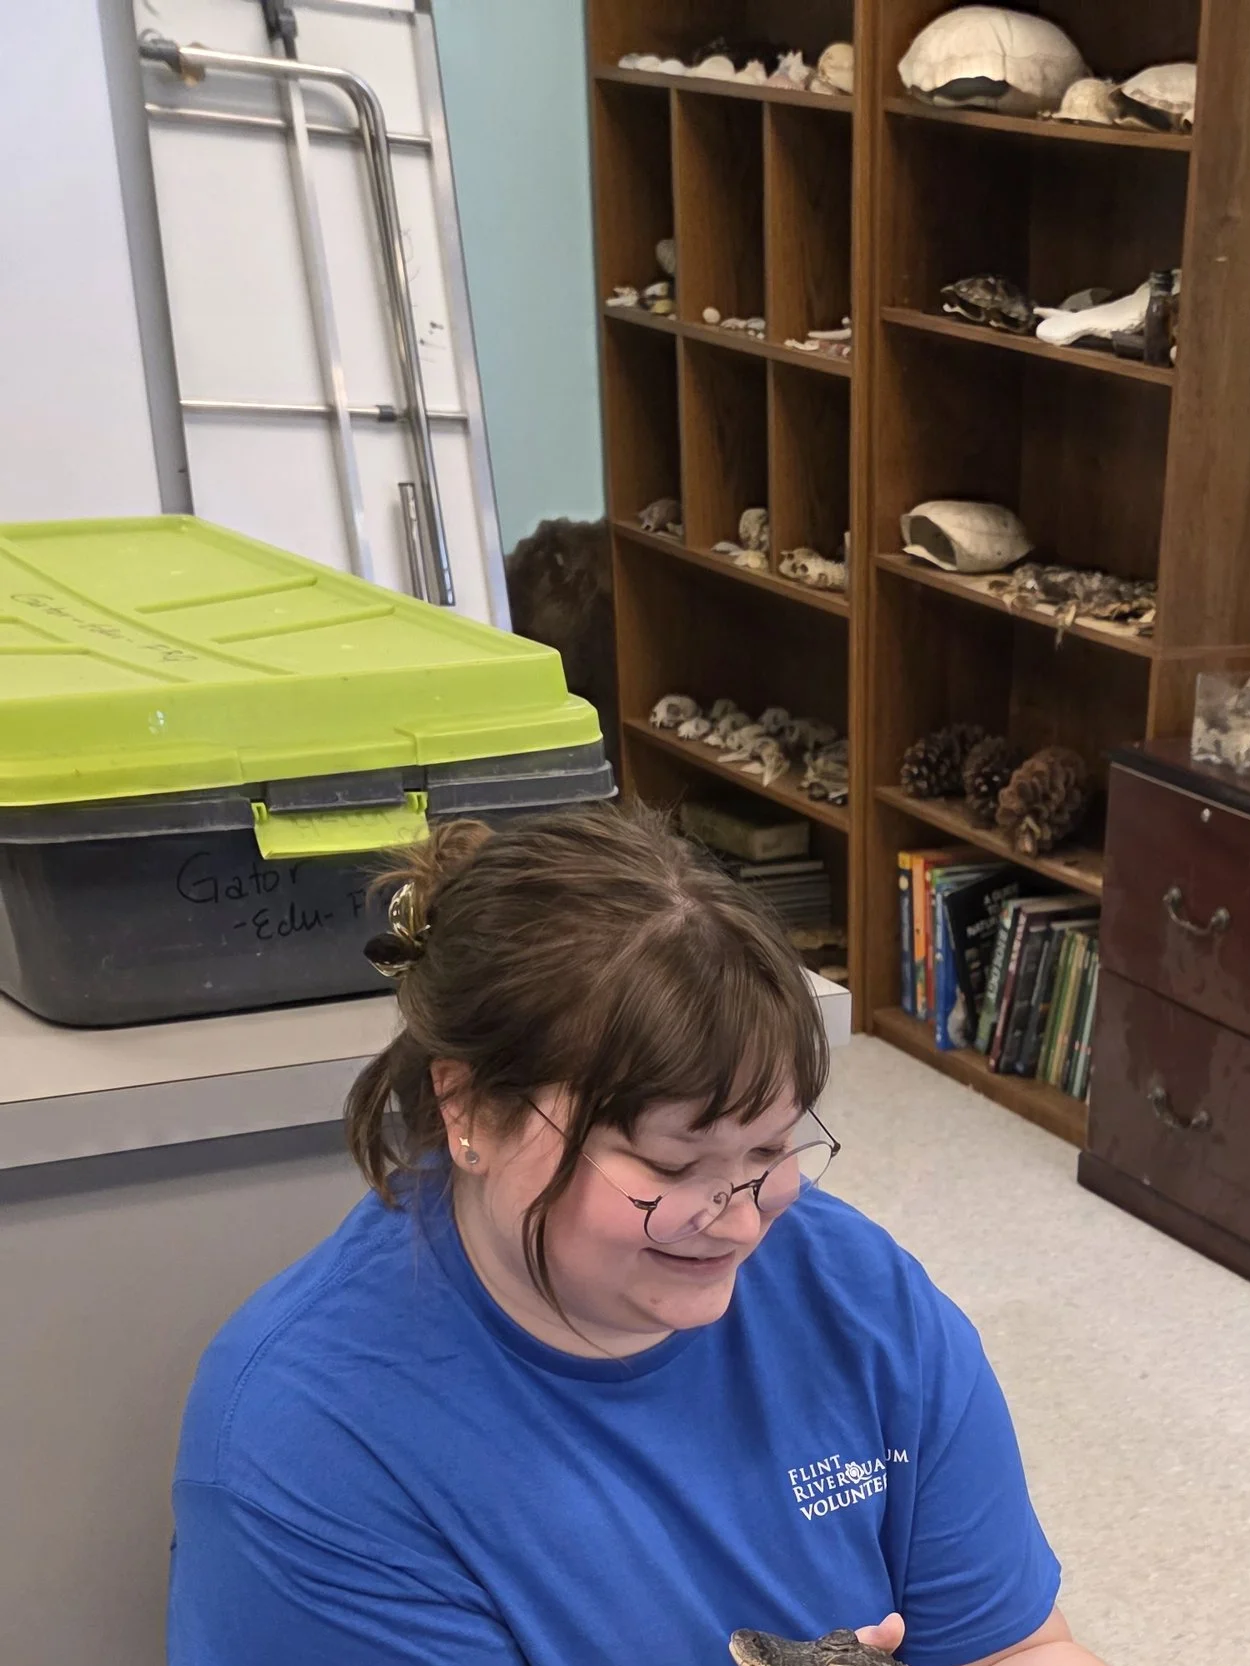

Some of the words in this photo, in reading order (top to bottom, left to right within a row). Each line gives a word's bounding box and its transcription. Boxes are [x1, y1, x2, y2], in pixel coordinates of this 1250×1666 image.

[176, 852, 312, 904] Gator
[788, 1454, 841, 1486] FLINT
[800, 1473, 888, 1521] VOLUNTE
